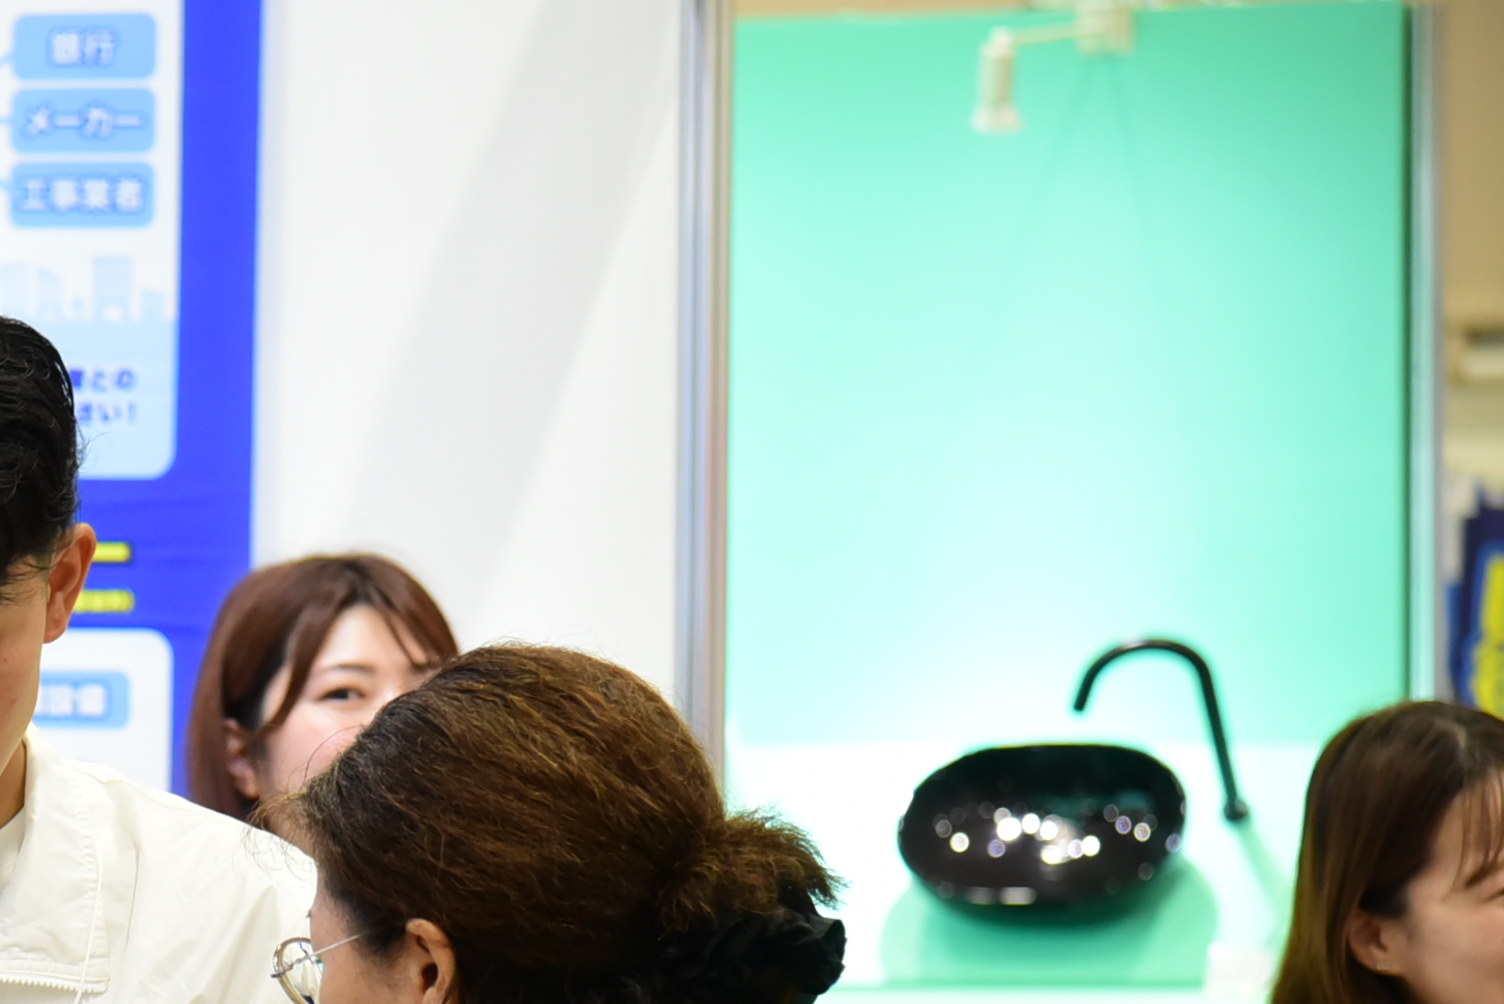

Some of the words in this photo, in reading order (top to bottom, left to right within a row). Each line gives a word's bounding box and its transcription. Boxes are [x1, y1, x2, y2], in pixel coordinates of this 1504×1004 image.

[24, 104, 143, 139] メーカー
[21, 176, 145, 213] 工事業者
